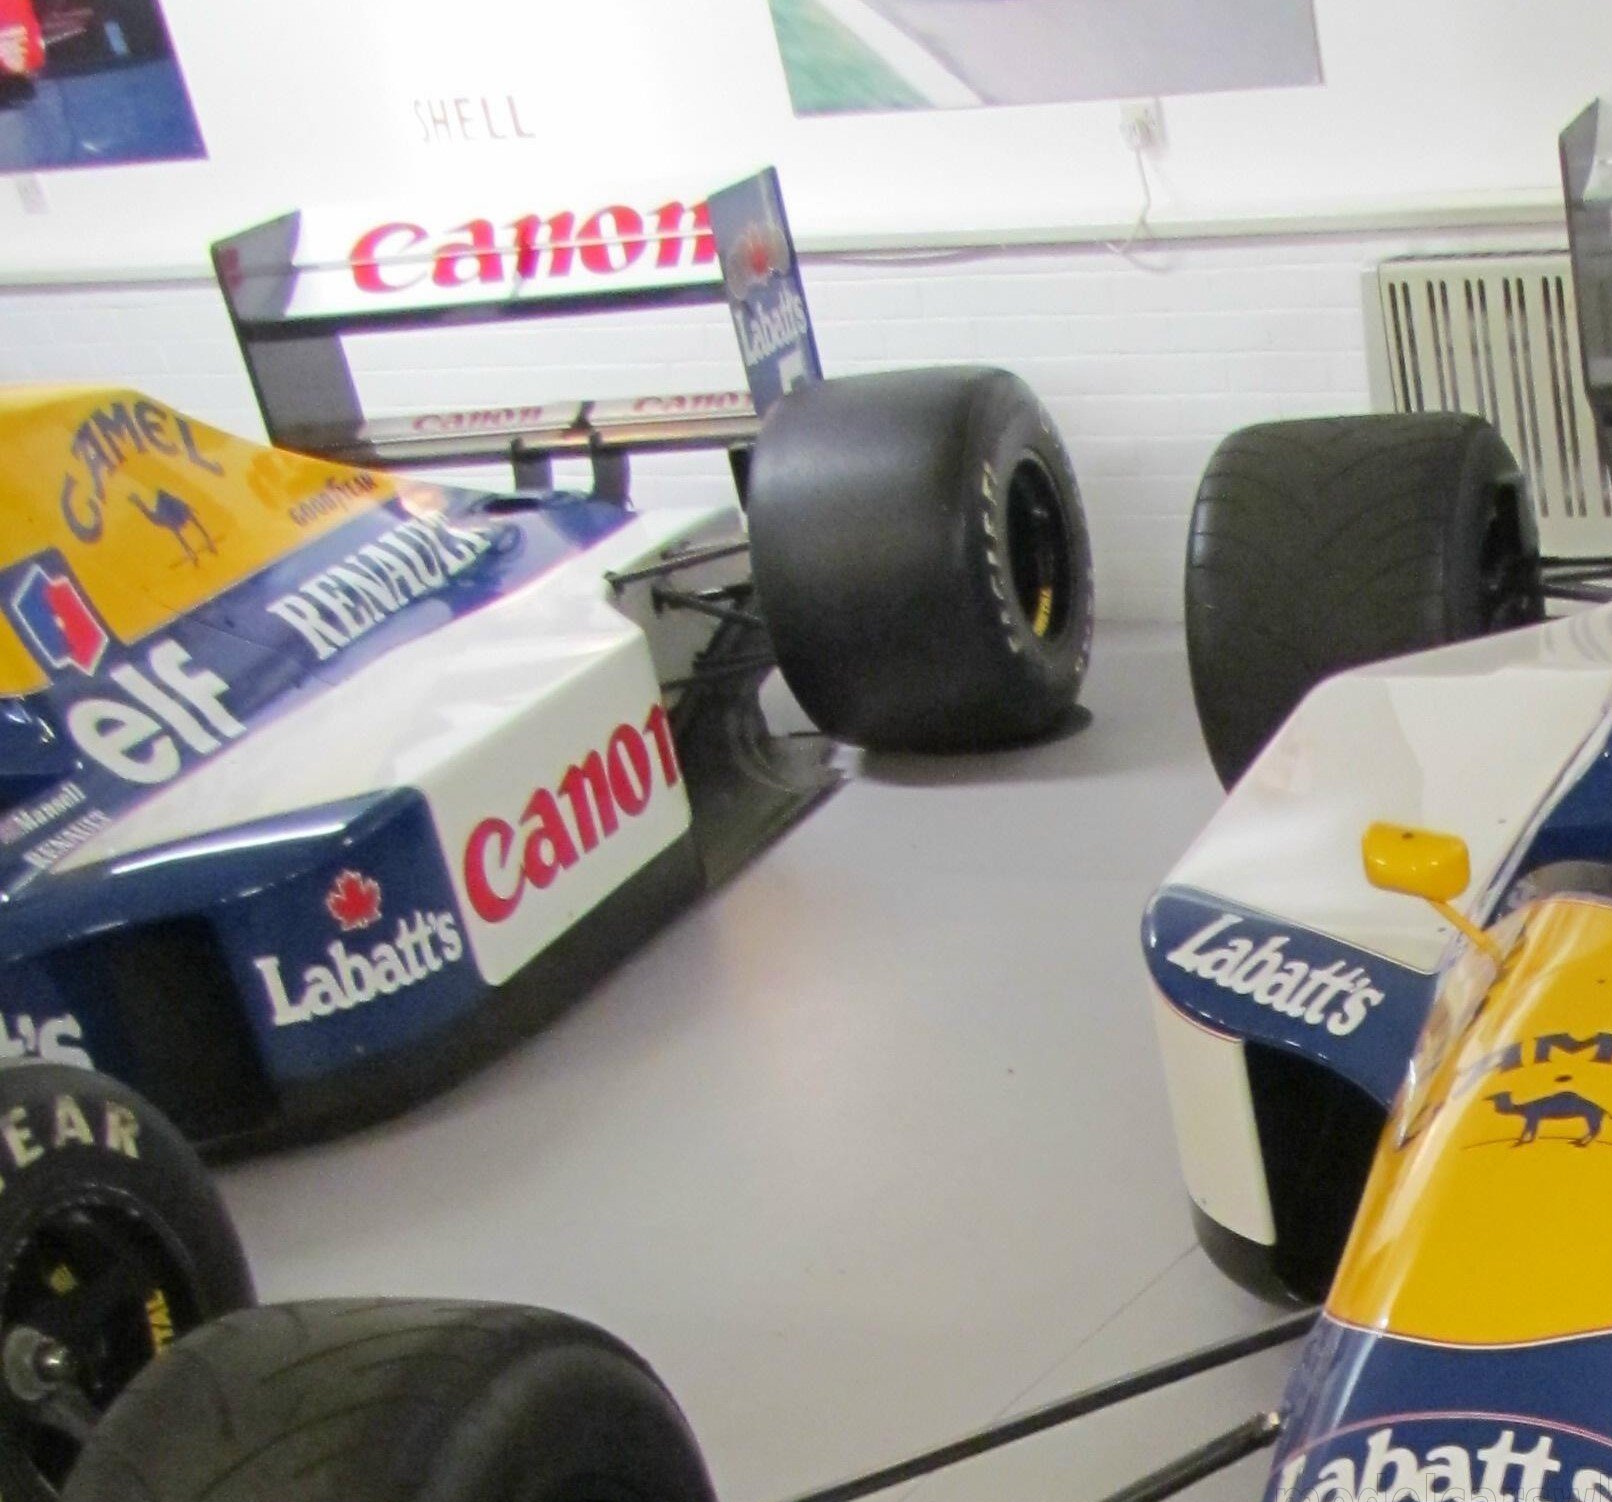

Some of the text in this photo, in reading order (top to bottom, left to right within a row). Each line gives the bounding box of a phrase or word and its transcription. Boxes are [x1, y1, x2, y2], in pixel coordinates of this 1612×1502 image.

[413, 95, 536, 143] SHELL
[348, 200, 717, 295] Canon
[633, 391, 752, 413] Cano
[61, 401, 225, 544] CAMEL
[67, 637, 248, 785] elf
[253, 908, 464, 1028] Labatt's
[1165, 913, 1386, 1036] Labatt's
[0, 1095, 140, 1169] EAR
